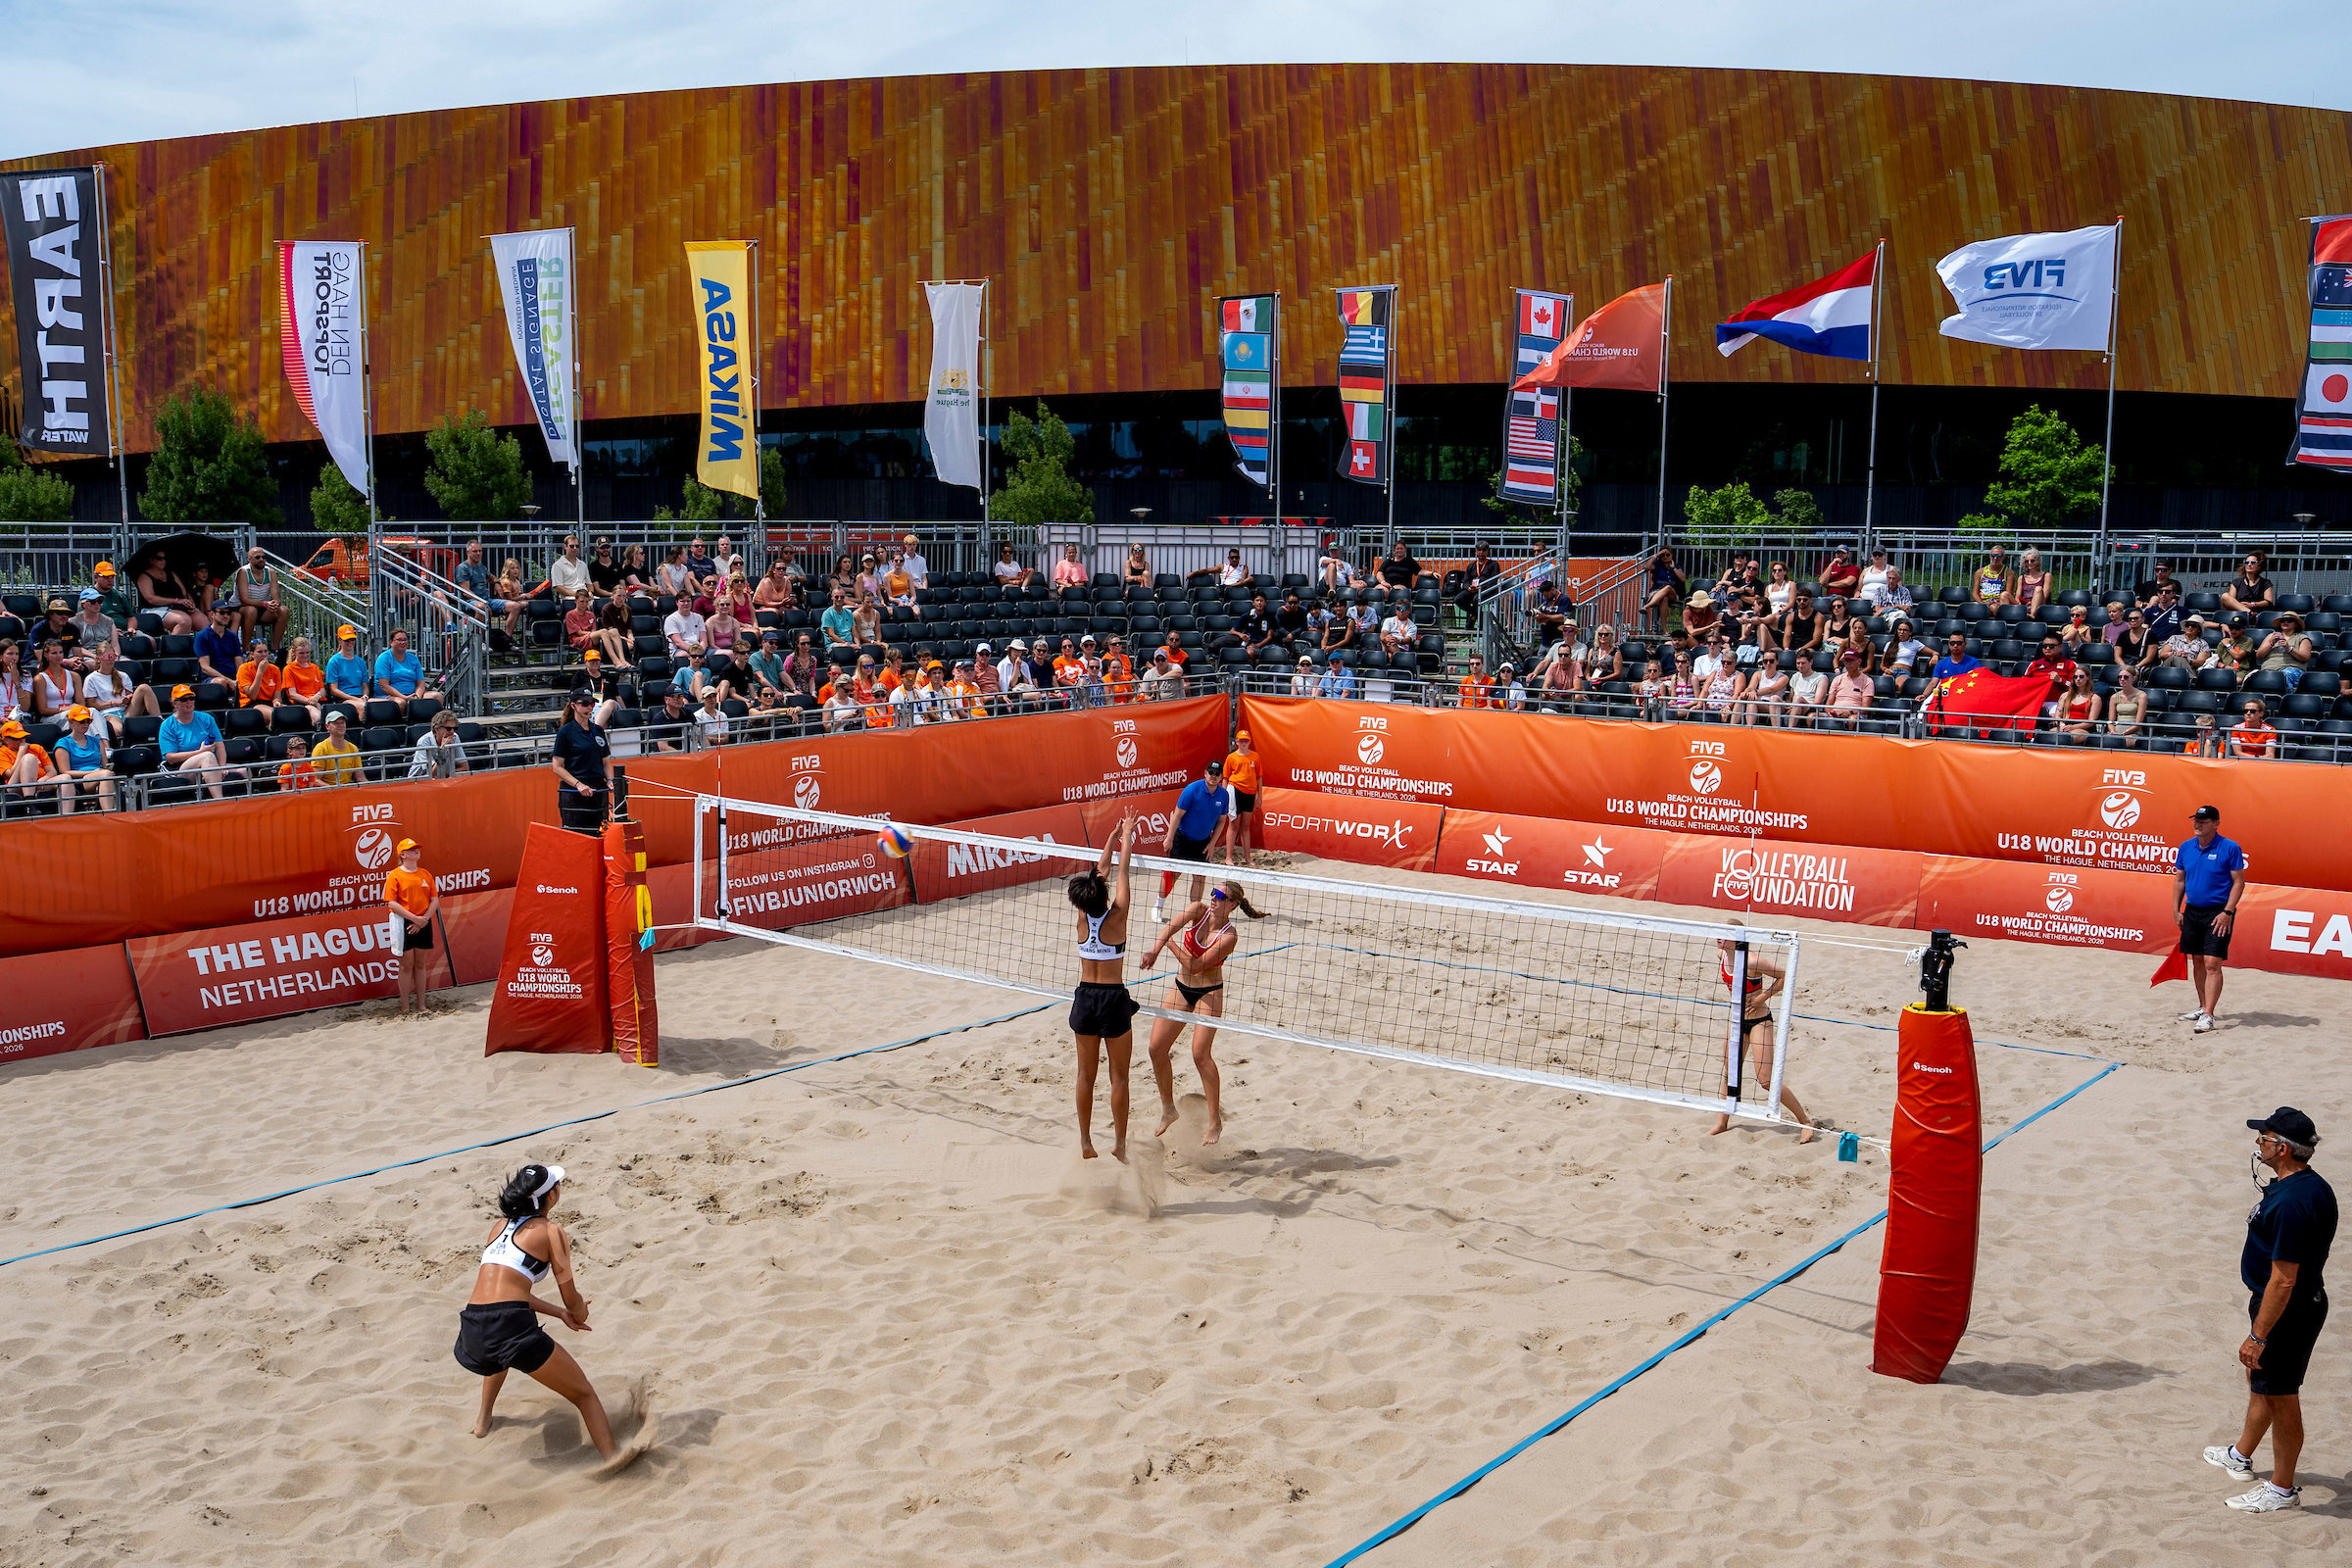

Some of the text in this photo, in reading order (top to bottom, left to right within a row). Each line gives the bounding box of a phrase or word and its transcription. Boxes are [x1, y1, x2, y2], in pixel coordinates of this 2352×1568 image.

[1113, 719, 1136, 732] FIVB
[1359, 716, 1388, 729] FIVB
[1690, 741, 1726, 755] FIVB
[791, 755, 821, 770] FIVB
[1103, 767, 1151, 780] BEACH VOLLEYBALL
[1361, 766, 1399, 776] VOLLEYBALL
[2103, 768, 2146, 785] FIVB
[1062, 786, 1083, 801] U18
[1085, 781, 1117, 799] WORLD
[1119, 769, 1188, 792] CHAMPIONSHIPS
[1291, 768, 1452, 796] U18 WORLD CHAMPIONSHIPS
[1399, 793, 1416, 802] 2026
[1667, 794, 1741, 808] BEACH VOLLEYBALL
[353, 804, 394, 822] FIVB
[1606, 799, 1807, 830] U18 WORLD CHAMPIONSHIPS
[1263, 811, 1413, 849] SPORTWORX
[1659, 818, 1687, 829] HAGUE,
[1688, 820, 1741, 834] NETHERLANDS,
[1742, 825, 1763, 834] 2026
[751, 826, 794, 847] WORLD
[2071, 829, 2165, 845] BEACH VOLLEYBALL
[1997, 833, 2031, 851] U18
[2035, 836, 2096, 857] WORLD
[1465, 858, 1518, 876] STAR
[1722, 848, 1848, 884] VOLLEYBALL
[2044, 855, 2178, 874] THE HAGUE, NETHERLANDS, 20
[329, 871, 389, 887] BEACH VOLLE
[727, 859, 859, 889] FOLLOW US ON INSTAGRAM
[1563, 870, 1620, 888] STAR
[2048, 872, 2078, 884] FIVB
[1712, 868, 1855, 911] FOUNDATION
[1729, 880, 1748, 890] FIVB
[254, 897, 289, 917] U18
[293, 887, 355, 911] WORLD
[2049, 913, 2088, 923] VOLLEYBALL
[1976, 913, 2143, 942] U18 WORLD CHAMPIONSHIPS
[530, 933, 553, 942] FIVB
[2019, 930, 2041, 939] HAGUE,
[2042, 933, 2087, 944] NETHERLANDS,
[187, 922, 392, 975] THE HAGUE
[200, 959, 400, 1008] NETHERLANDS
[517, 973, 570, 983] U18 WORLD
[508, 982, 581, 994] CHAMPIONSHIPS
[4, 1044, 24, 1054] 2026
[1921, 1064, 1953, 1074] Senoh
